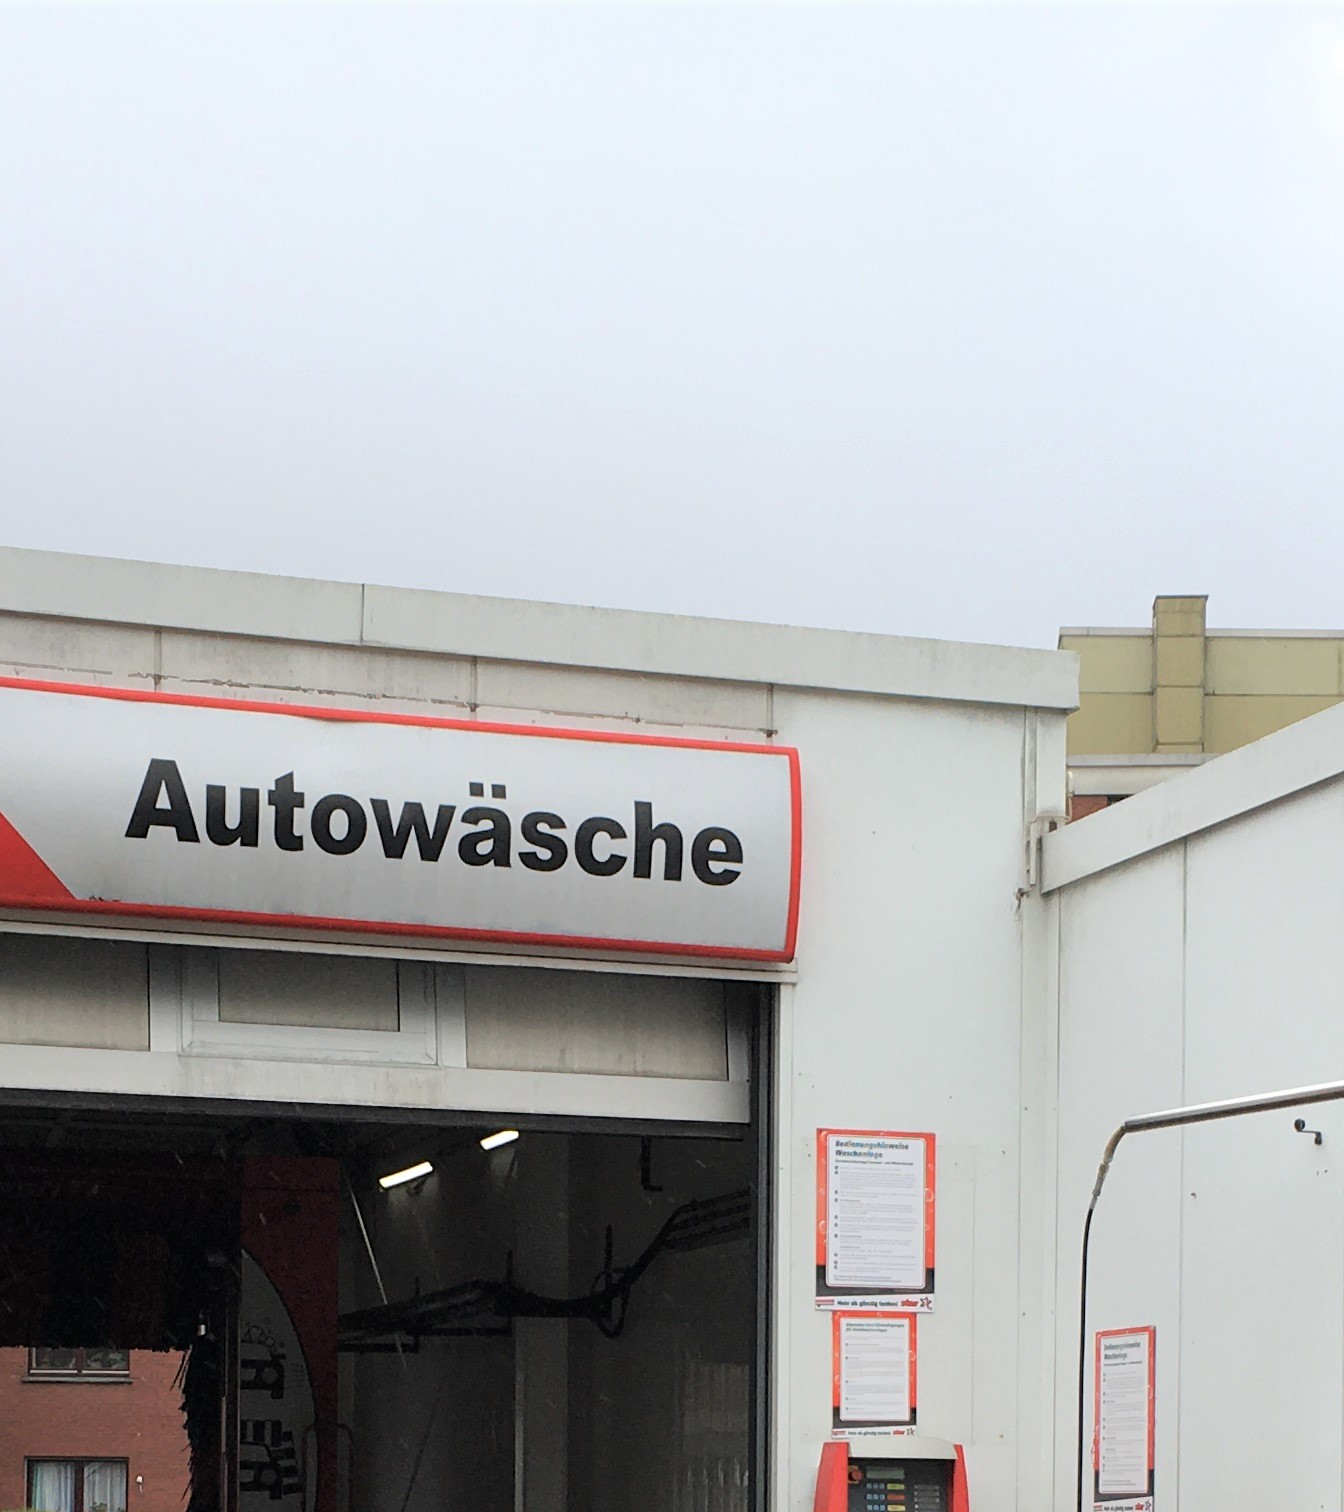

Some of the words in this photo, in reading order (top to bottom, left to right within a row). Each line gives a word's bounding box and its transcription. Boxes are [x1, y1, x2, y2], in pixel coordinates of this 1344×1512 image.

[124, 759, 744, 886] Autowäsche
[835, 1140, 909, 1150] Bedienungshinweise
[835, 1150, 883, 1160] Waschanlage
